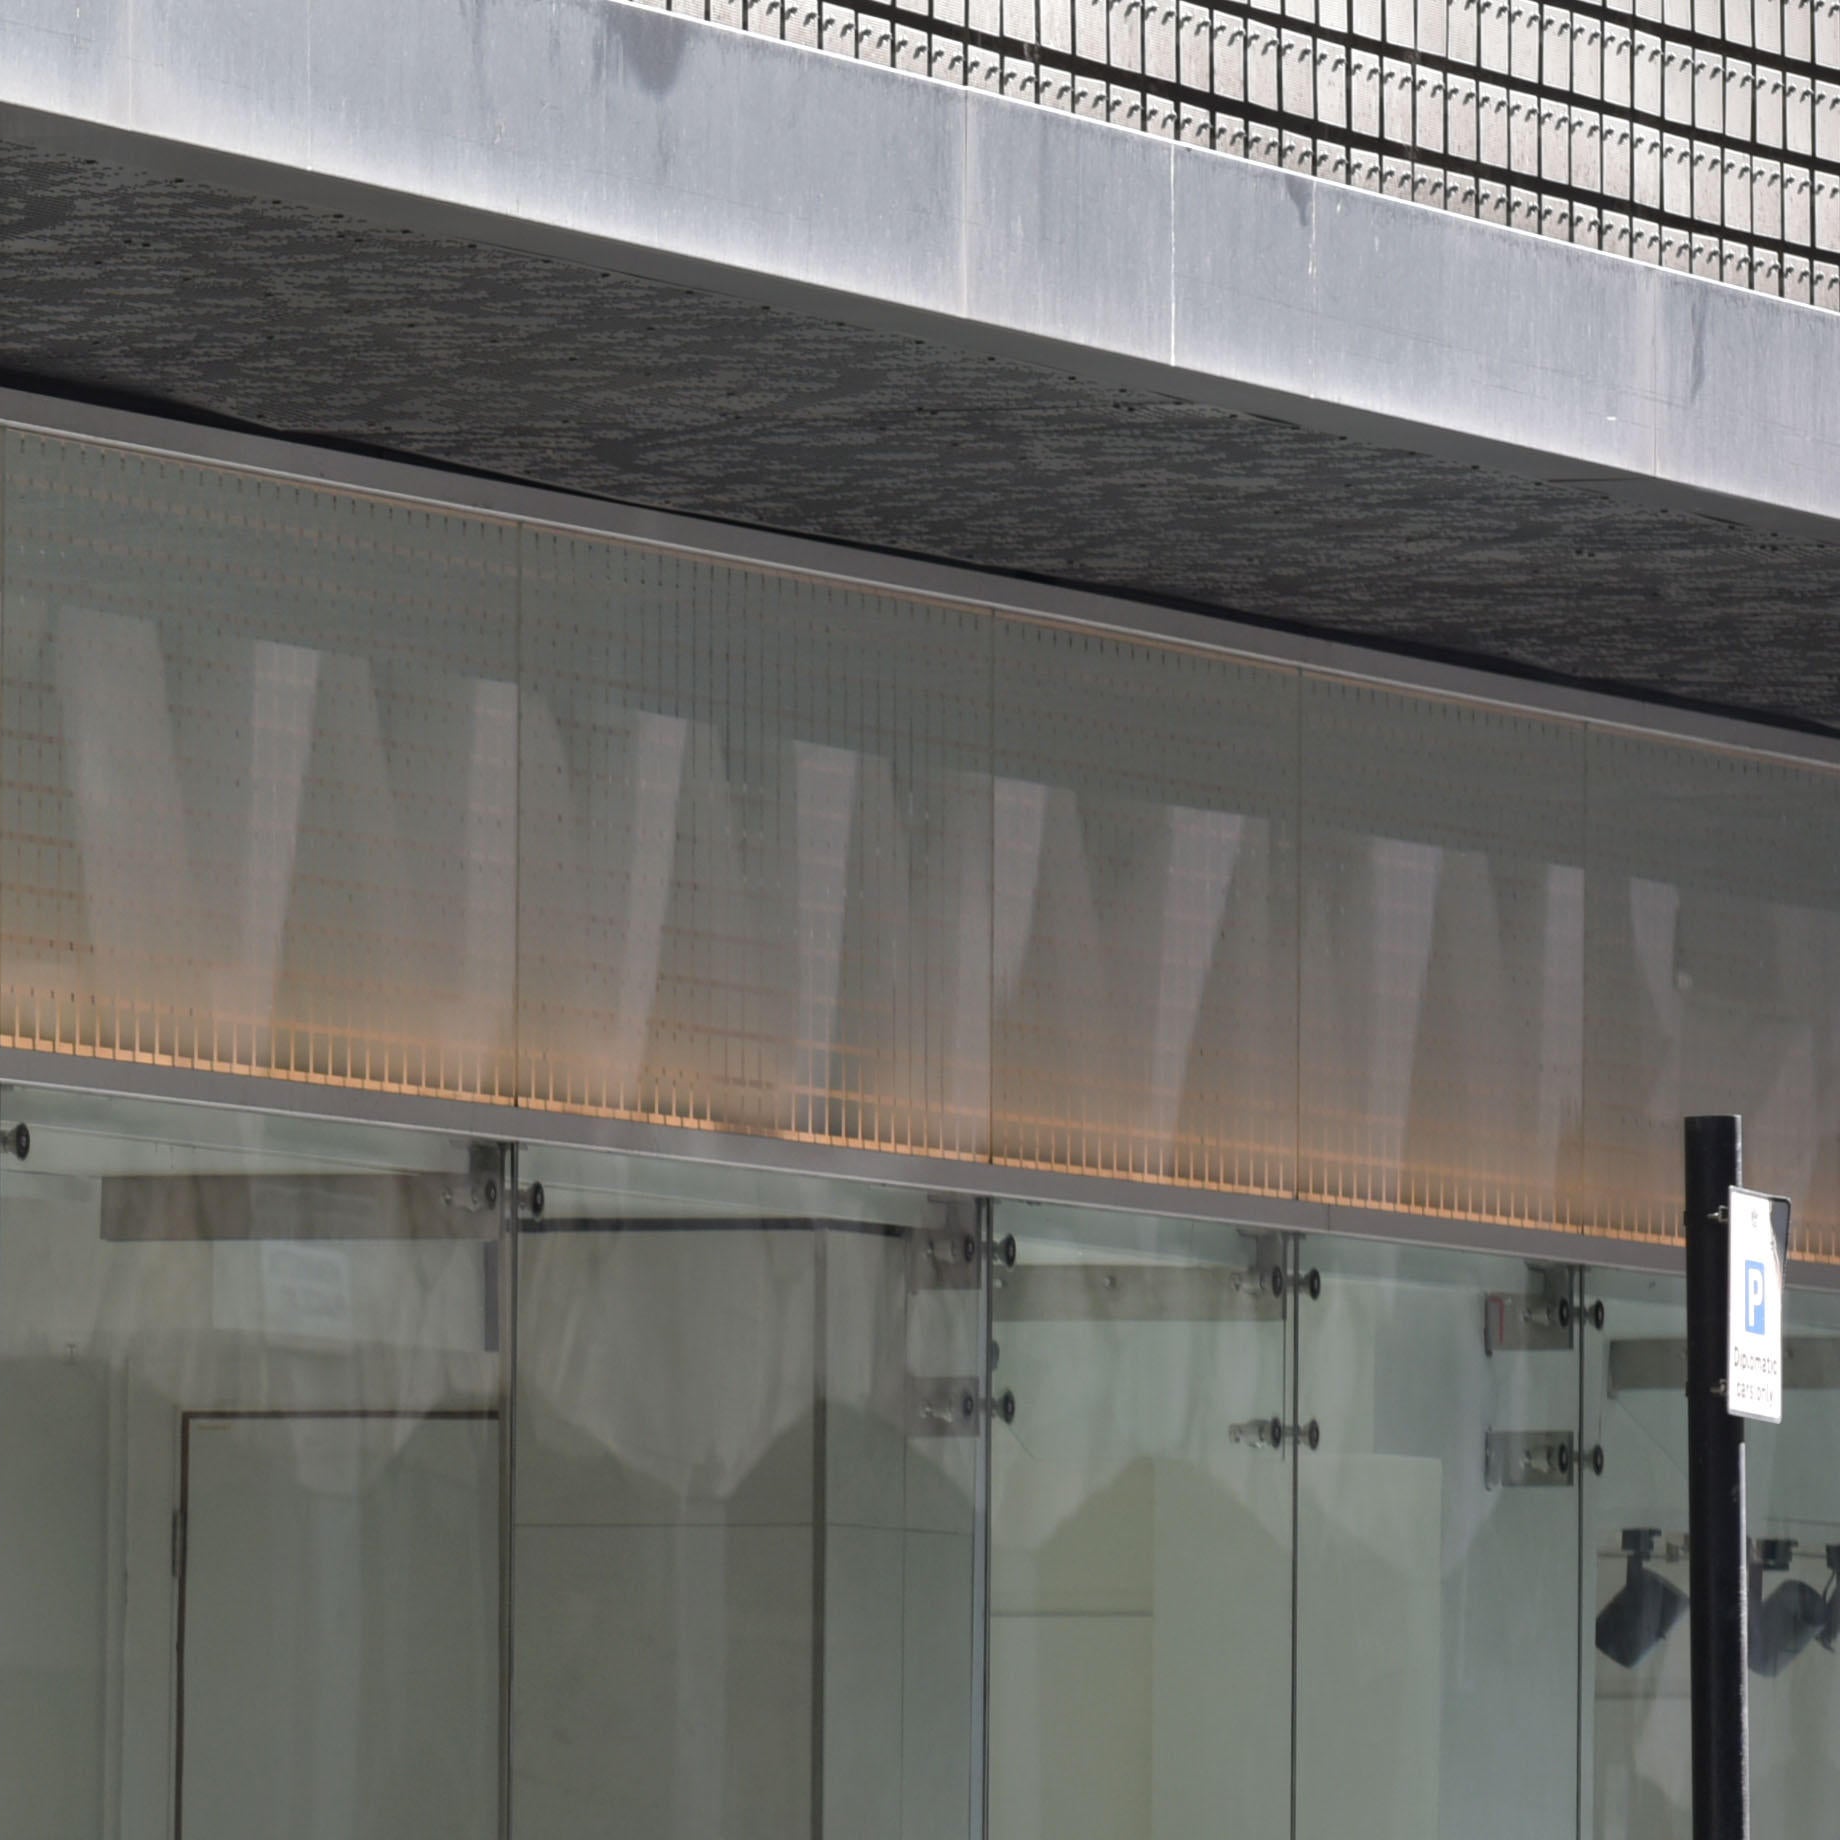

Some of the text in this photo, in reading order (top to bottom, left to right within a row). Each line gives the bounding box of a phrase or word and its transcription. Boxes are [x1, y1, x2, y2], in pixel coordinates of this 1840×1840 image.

[1748, 1268, 1763, 1327] P
[1734, 1346, 1777, 1375] Diplomatic
[1737, 1382, 1753, 1400] cars
